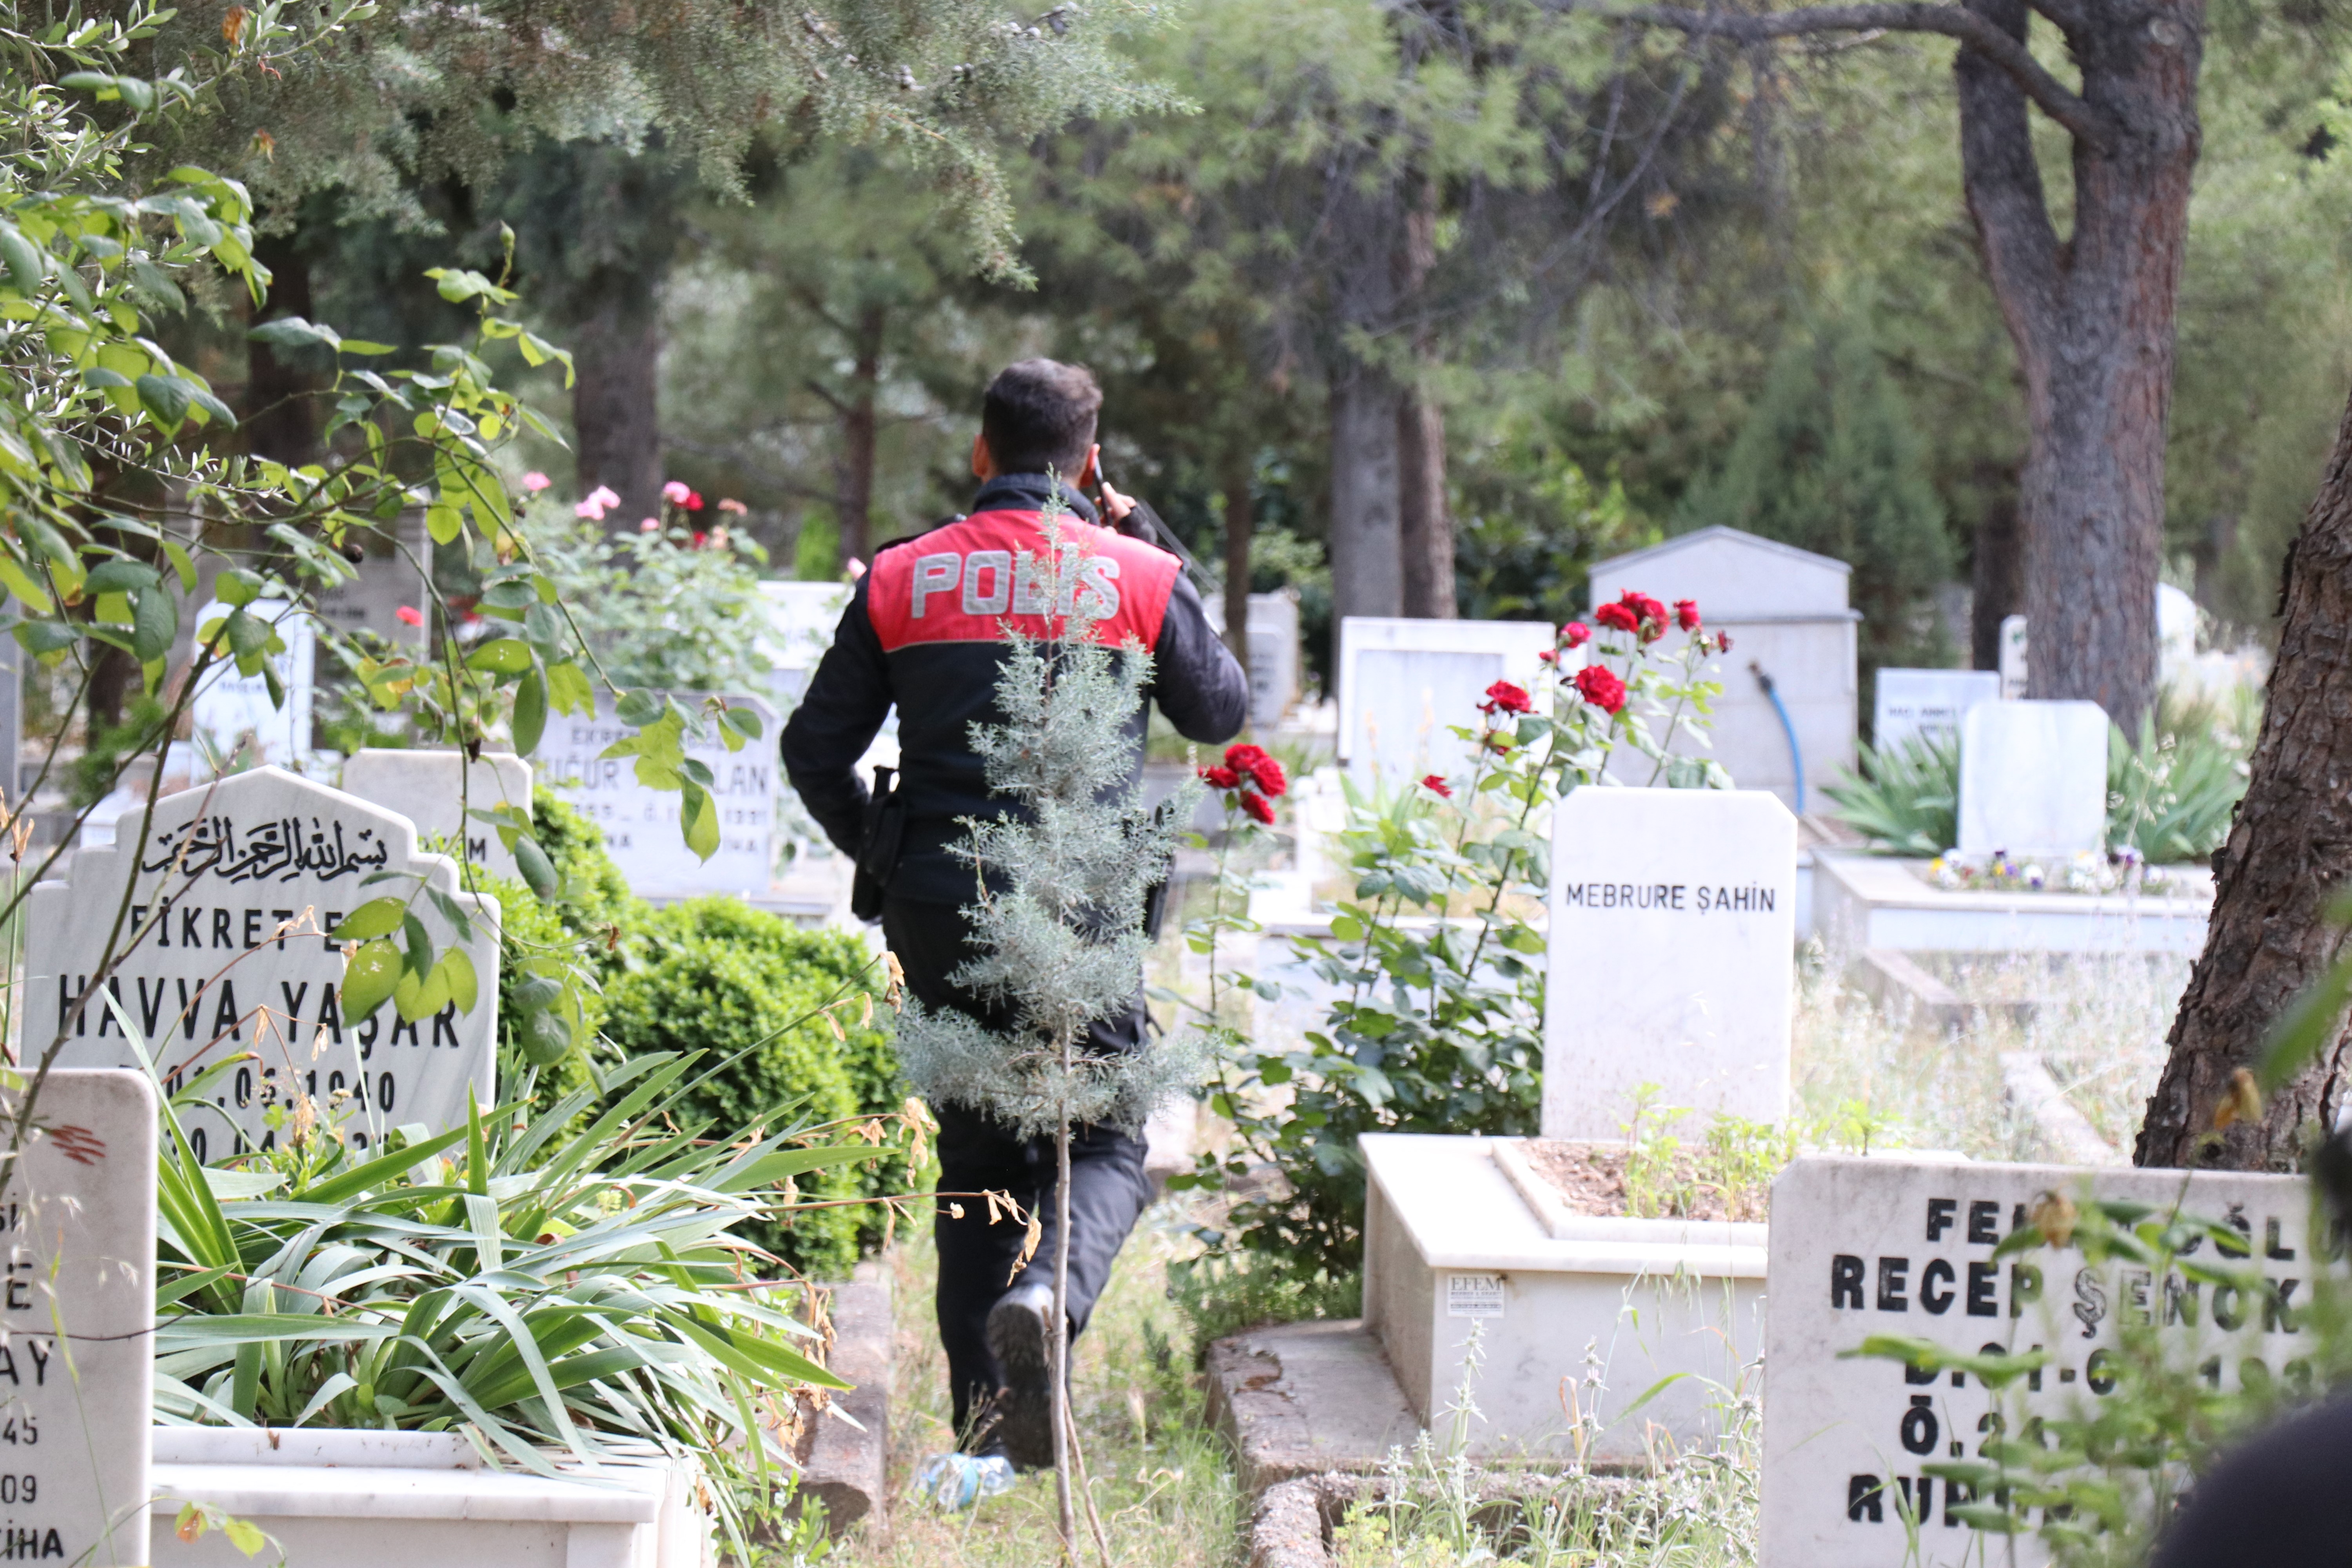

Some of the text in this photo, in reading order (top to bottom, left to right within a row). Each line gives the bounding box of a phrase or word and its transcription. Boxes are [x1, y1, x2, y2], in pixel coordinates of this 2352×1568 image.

[1567, 881, 1775, 915] MEBRURE ŞAHİN
[131, 897, 294, 950] FİKRET
[58, 974, 240, 1041] HAVVA
[1451, 1278, 1501, 1291] EFEM
[1831, 1254, 2044, 1319] RECEP
[2, 1474, 37, 1504] 09
[0, 1519, 64, 1560] İHA
